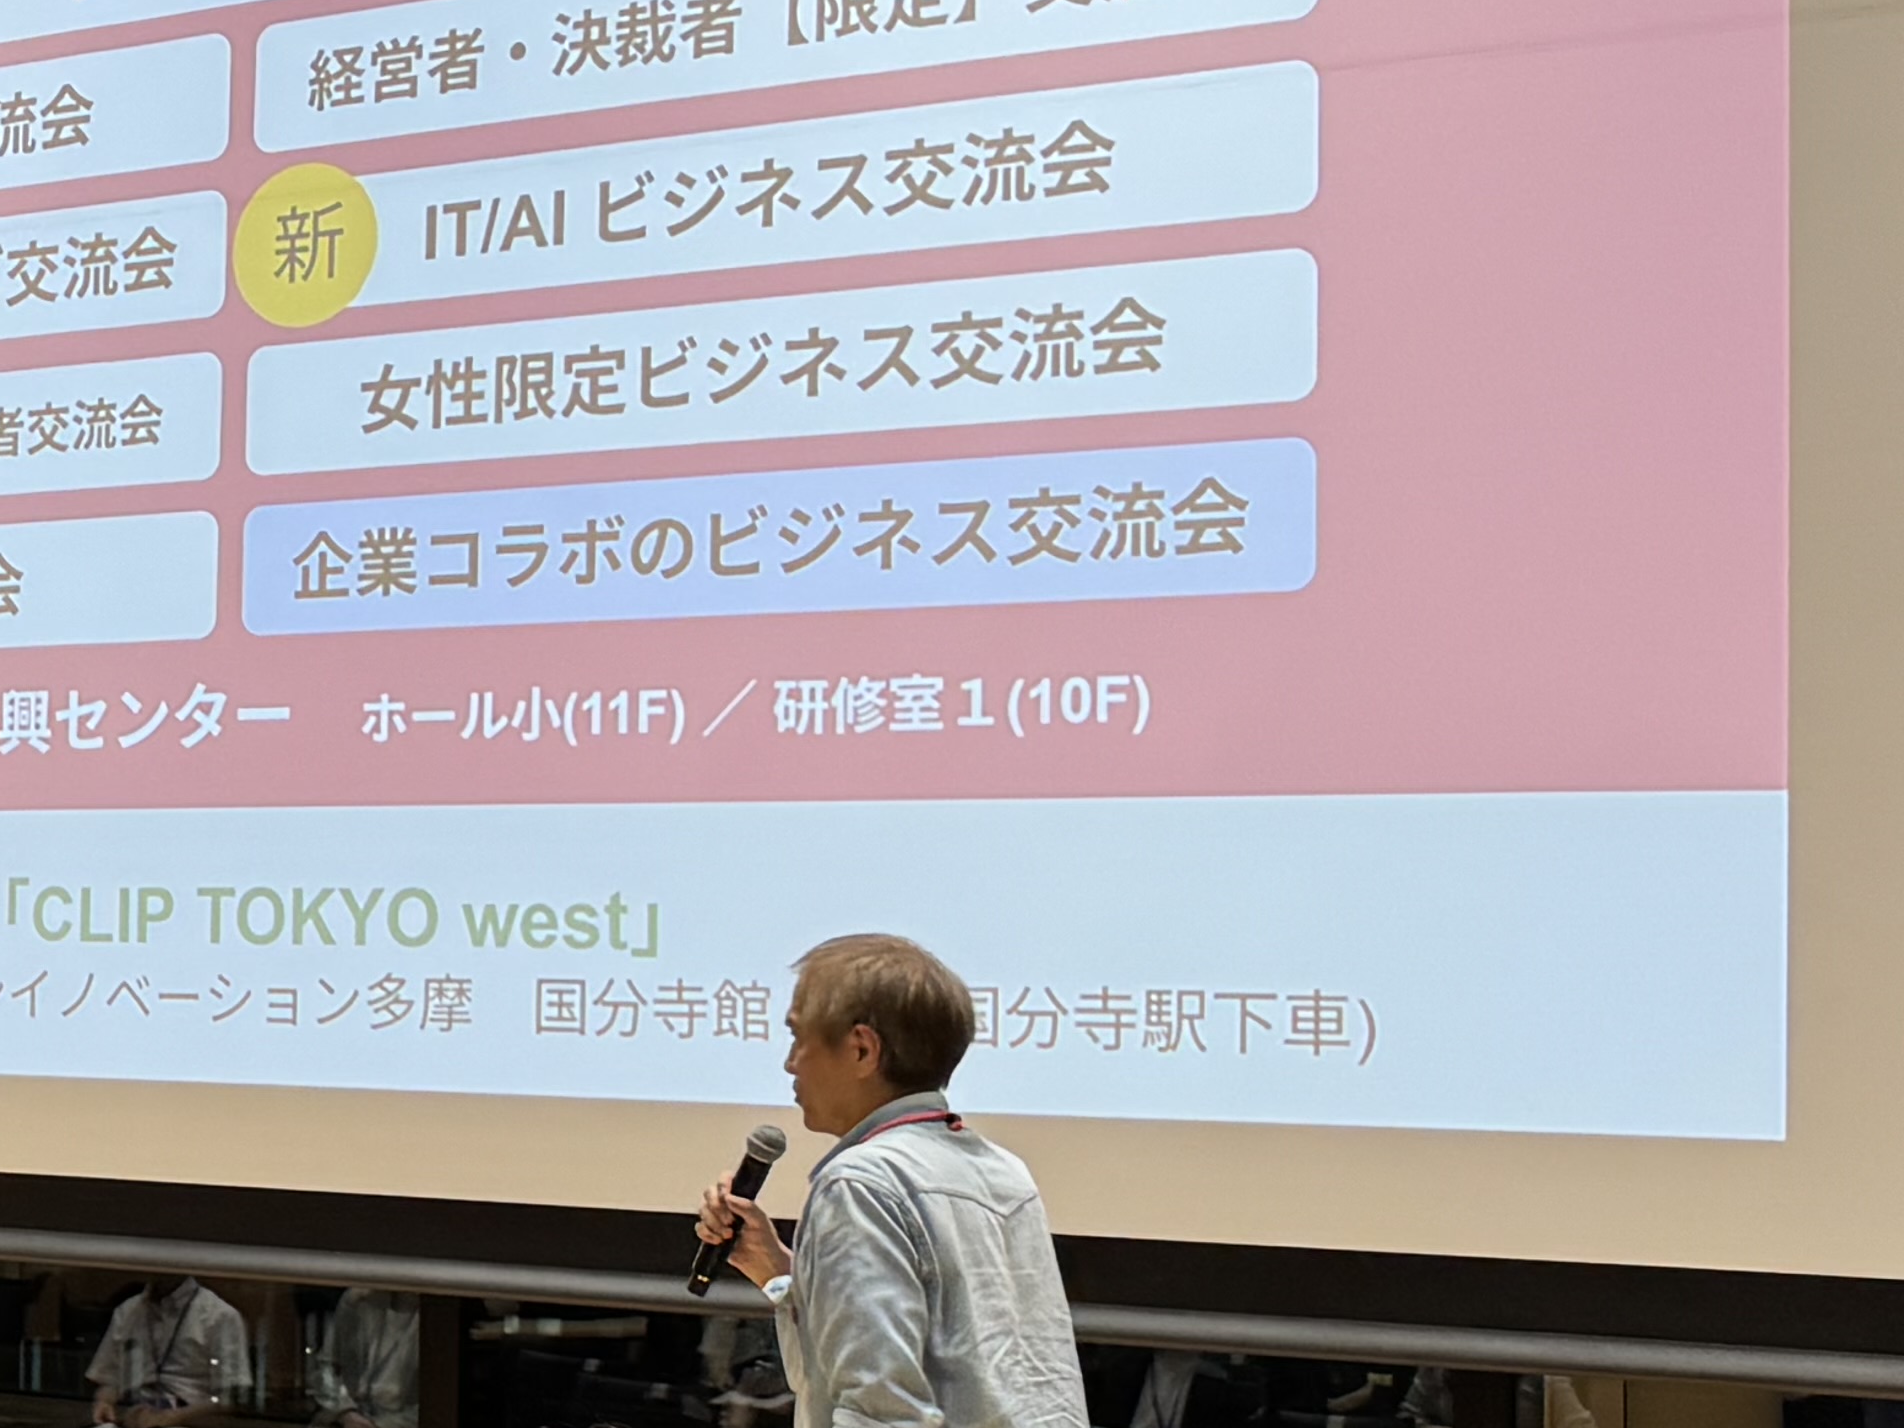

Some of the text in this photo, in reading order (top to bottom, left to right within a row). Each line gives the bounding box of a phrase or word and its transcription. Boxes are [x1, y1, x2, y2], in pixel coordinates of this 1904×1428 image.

[272, 200, 345, 285] 新
[360, 295, 1168, 436] 女性限定ビジネス交流会
[291, 476, 1250, 602] 企業コラボのビジネス交流会
[196, 883, 440, 951] TOKYO
